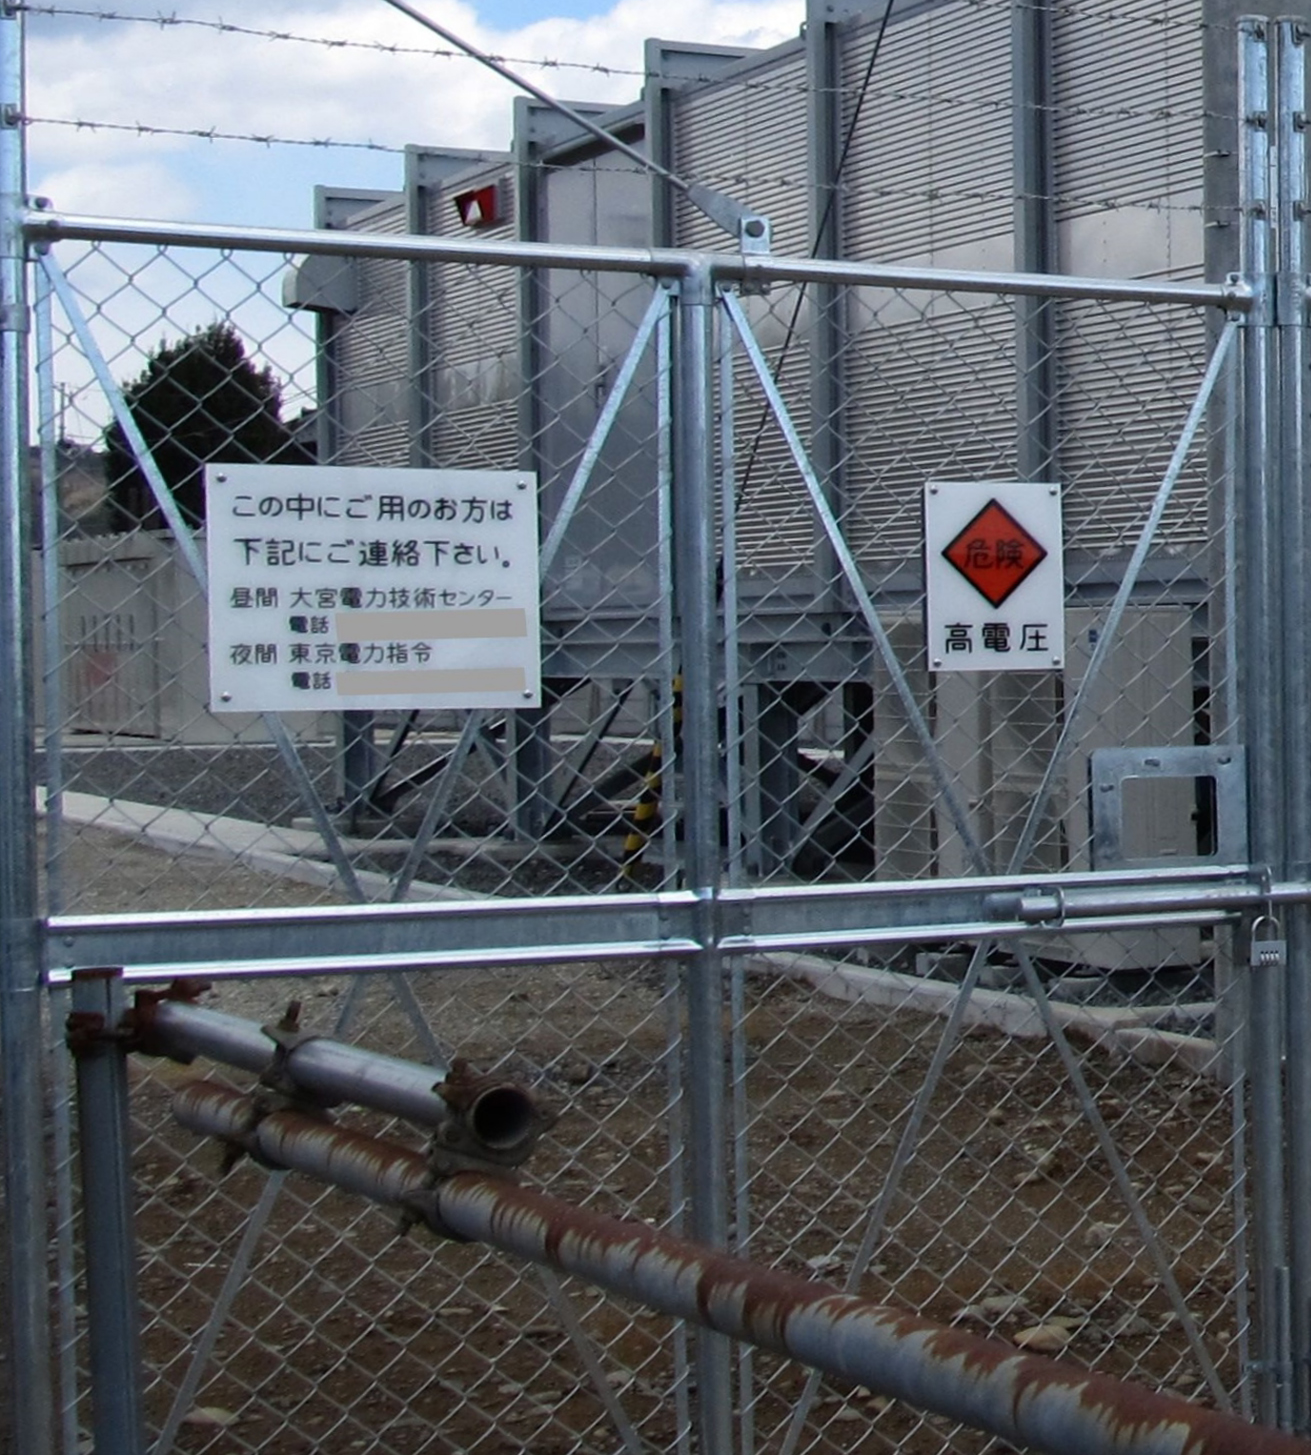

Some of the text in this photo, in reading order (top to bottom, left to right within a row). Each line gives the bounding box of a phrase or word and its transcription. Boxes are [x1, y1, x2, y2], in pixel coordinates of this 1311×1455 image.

[232, 493, 513, 523] この中にご用のお方は
[233, 539, 511, 568] 下記にご連絡下さい。
[964, 539, 1025, 570] 危険
[229, 587, 512, 609] 昼間 大宮電力技術センター
[289, 615, 329, 634] 電話
[944, 623, 1049, 654] 高電圧
[229, 642, 433, 665] 夜間 東京電力指令
[291, 672, 332, 690] 電話
